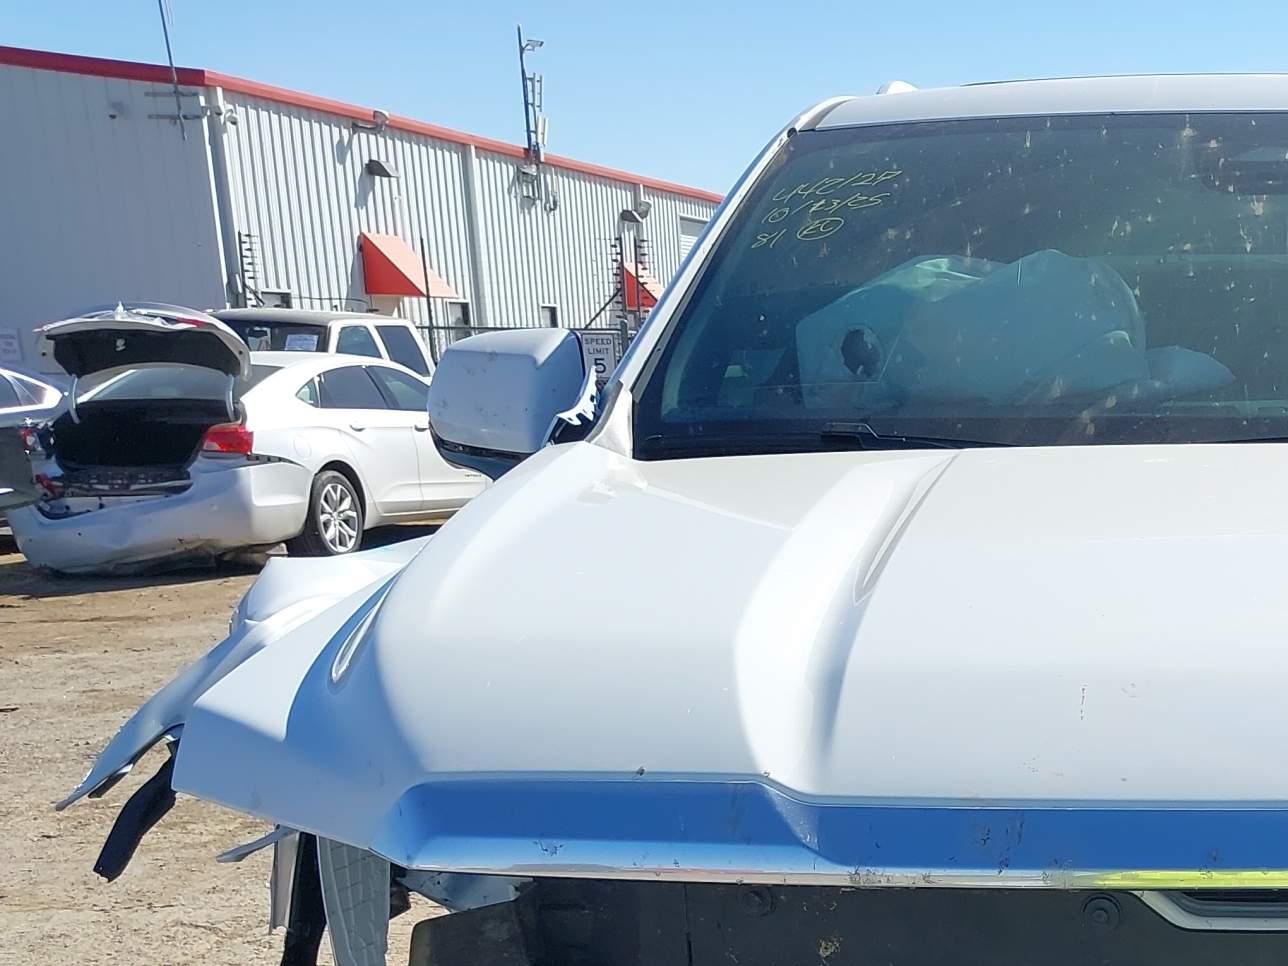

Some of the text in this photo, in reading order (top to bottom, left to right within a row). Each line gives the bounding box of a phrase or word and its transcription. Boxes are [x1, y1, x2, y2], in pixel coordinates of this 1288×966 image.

[584, 337, 612, 345] SPEED
[587, 346, 609, 355] LIMIT
[594, 357, 607, 374] 5
